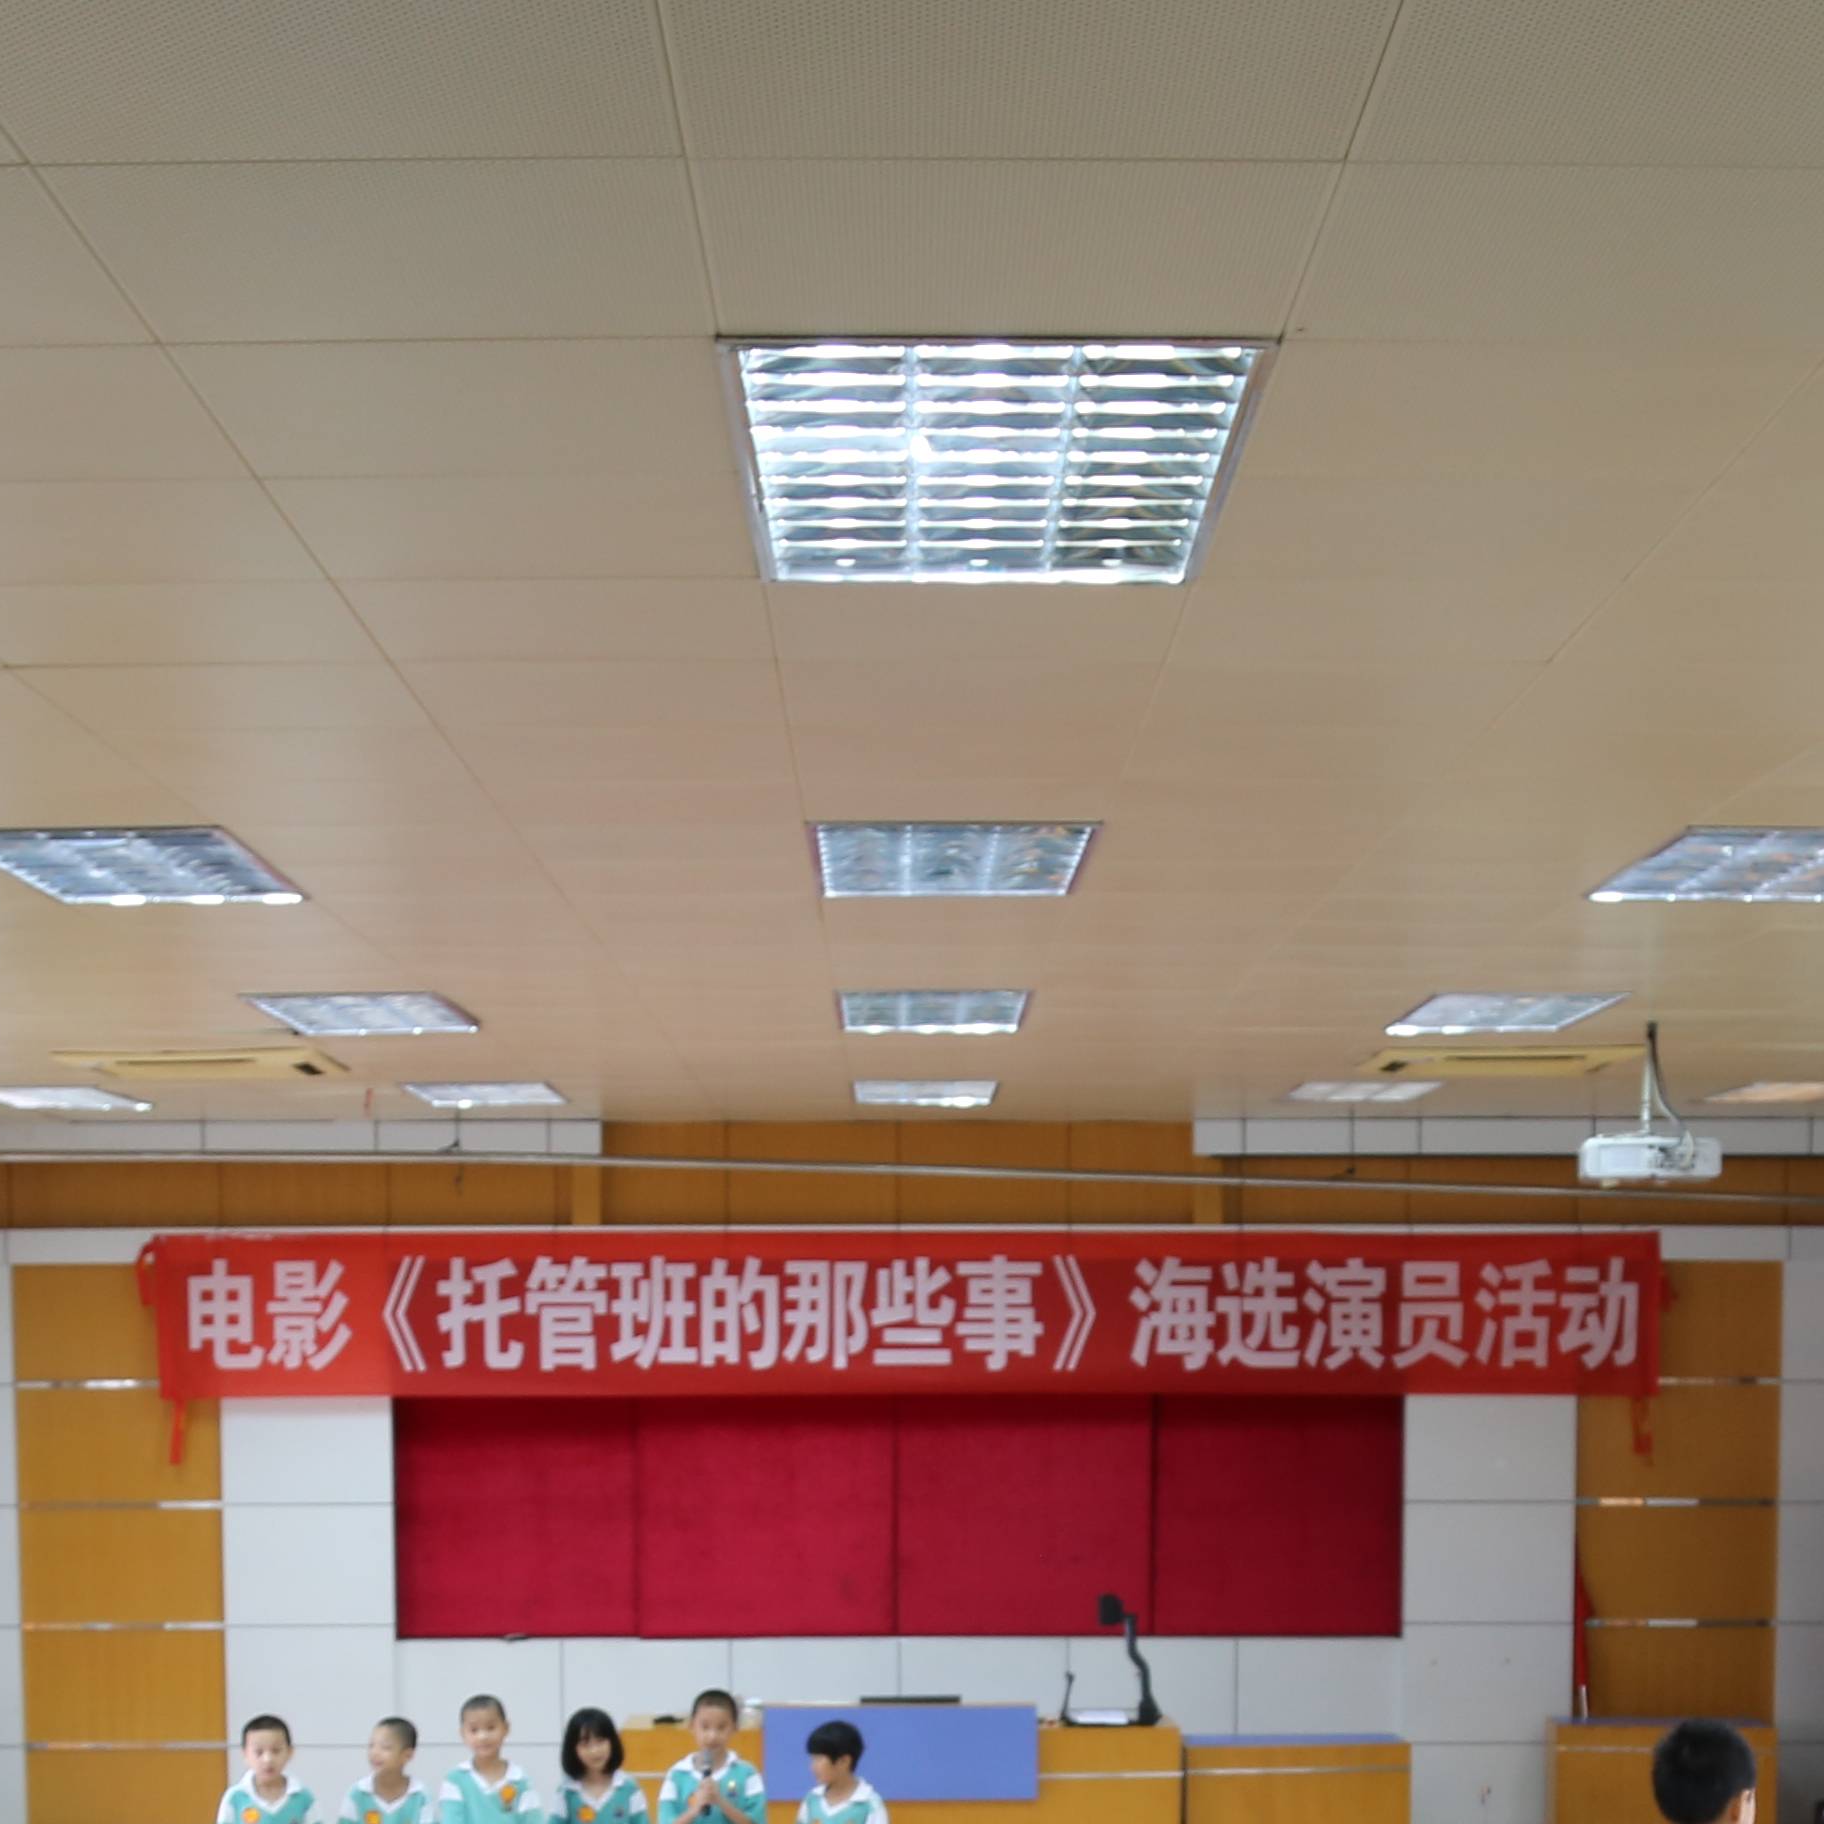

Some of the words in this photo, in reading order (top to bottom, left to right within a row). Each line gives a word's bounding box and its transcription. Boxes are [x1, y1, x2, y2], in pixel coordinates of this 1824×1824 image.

[186, 1255, 1639, 1372] 电影《托管班的那些事》海选演员活动
